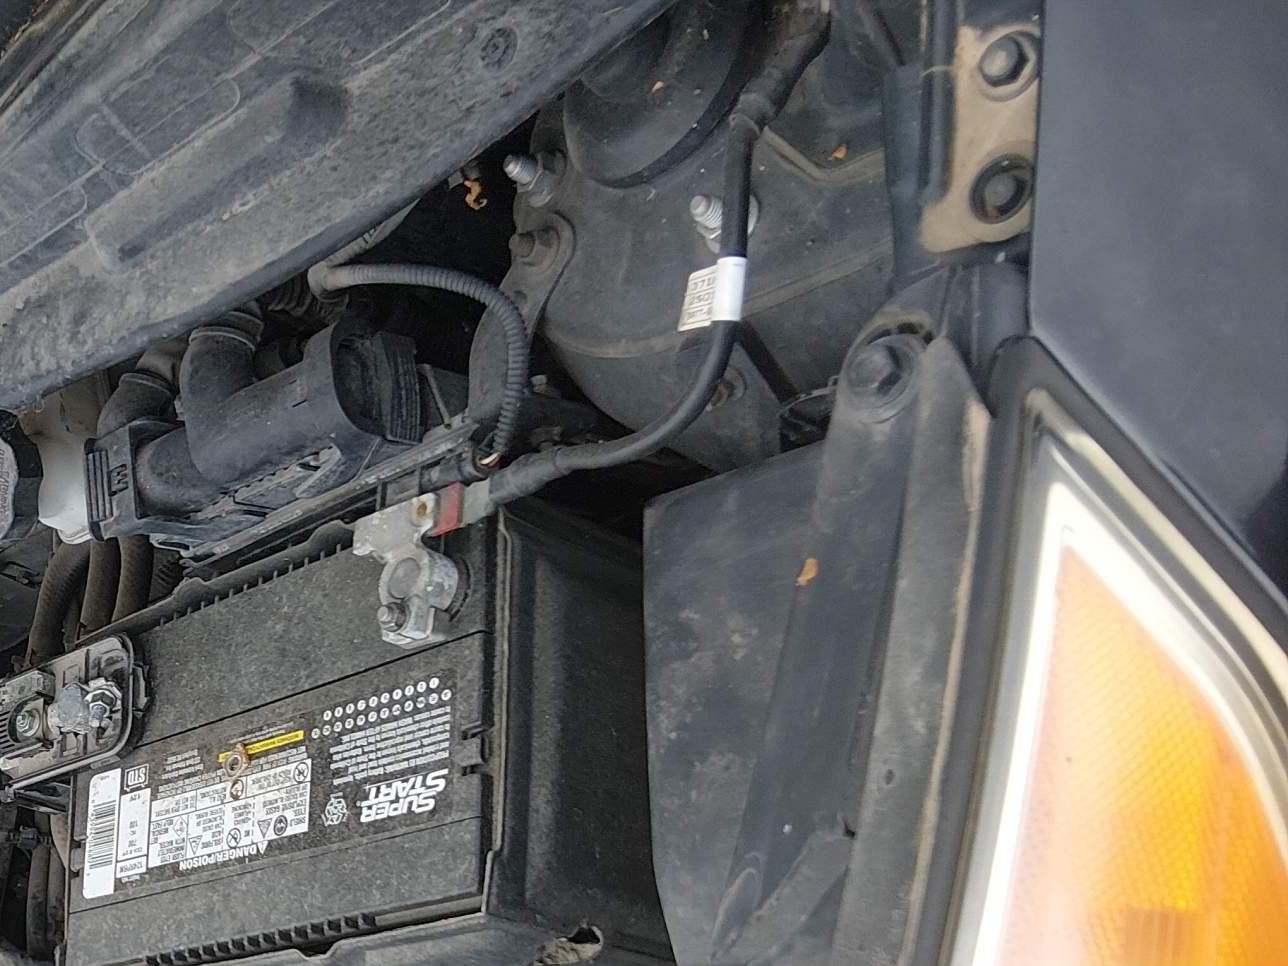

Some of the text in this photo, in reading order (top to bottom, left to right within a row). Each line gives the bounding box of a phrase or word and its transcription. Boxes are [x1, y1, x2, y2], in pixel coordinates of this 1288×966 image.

[127, 768, 145, 784] STD
[360, 768, 450, 807] START
[359, 789, 437, 823] SUPER
[178, 846, 259, 871] DANGER/POISON
